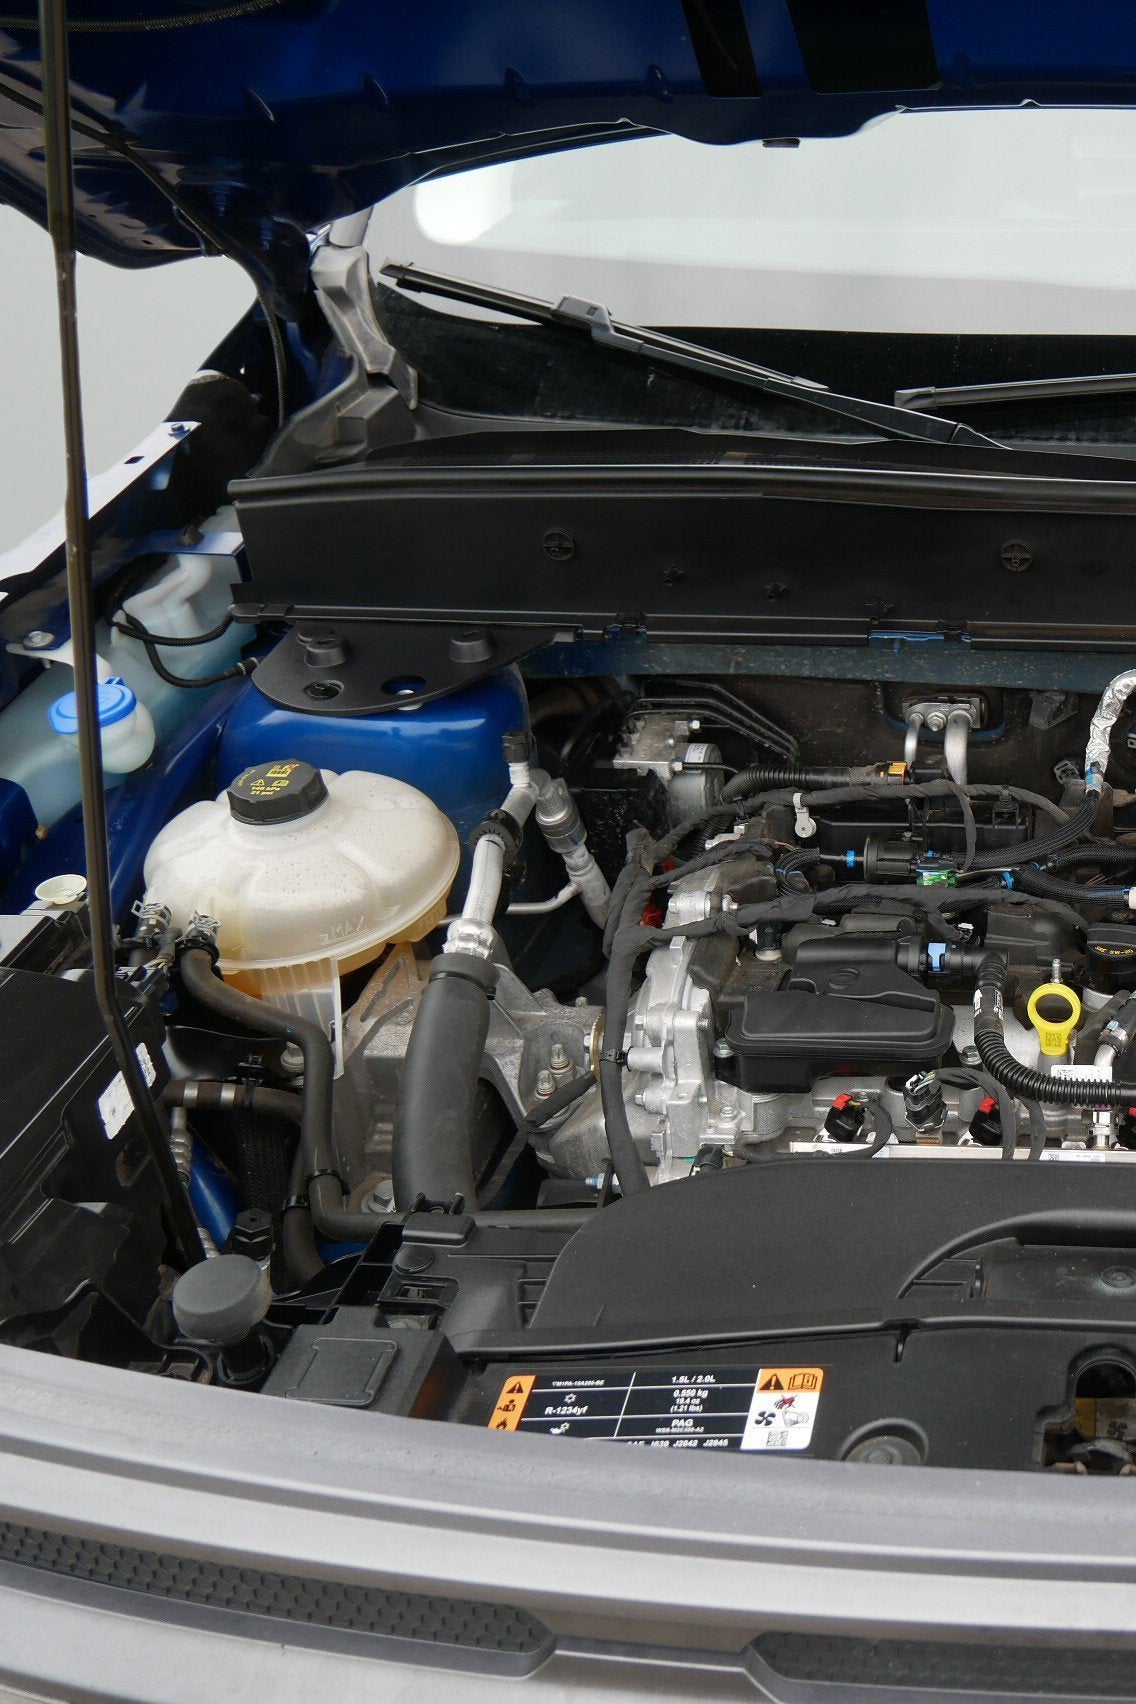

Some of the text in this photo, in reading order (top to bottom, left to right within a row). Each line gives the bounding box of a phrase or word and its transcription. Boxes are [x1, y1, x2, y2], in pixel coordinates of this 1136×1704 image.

[671, 1375, 690, 1384] 1.5L
[696, 1374, 716, 1383] 2.0L
[696, 1388, 709, 1399] kg
[544, 1405, 588, 1416] R-1234yf
[669, 1404, 703, 1413] (1.21 lbs)
[671, 1418, 694, 1427] PAG
